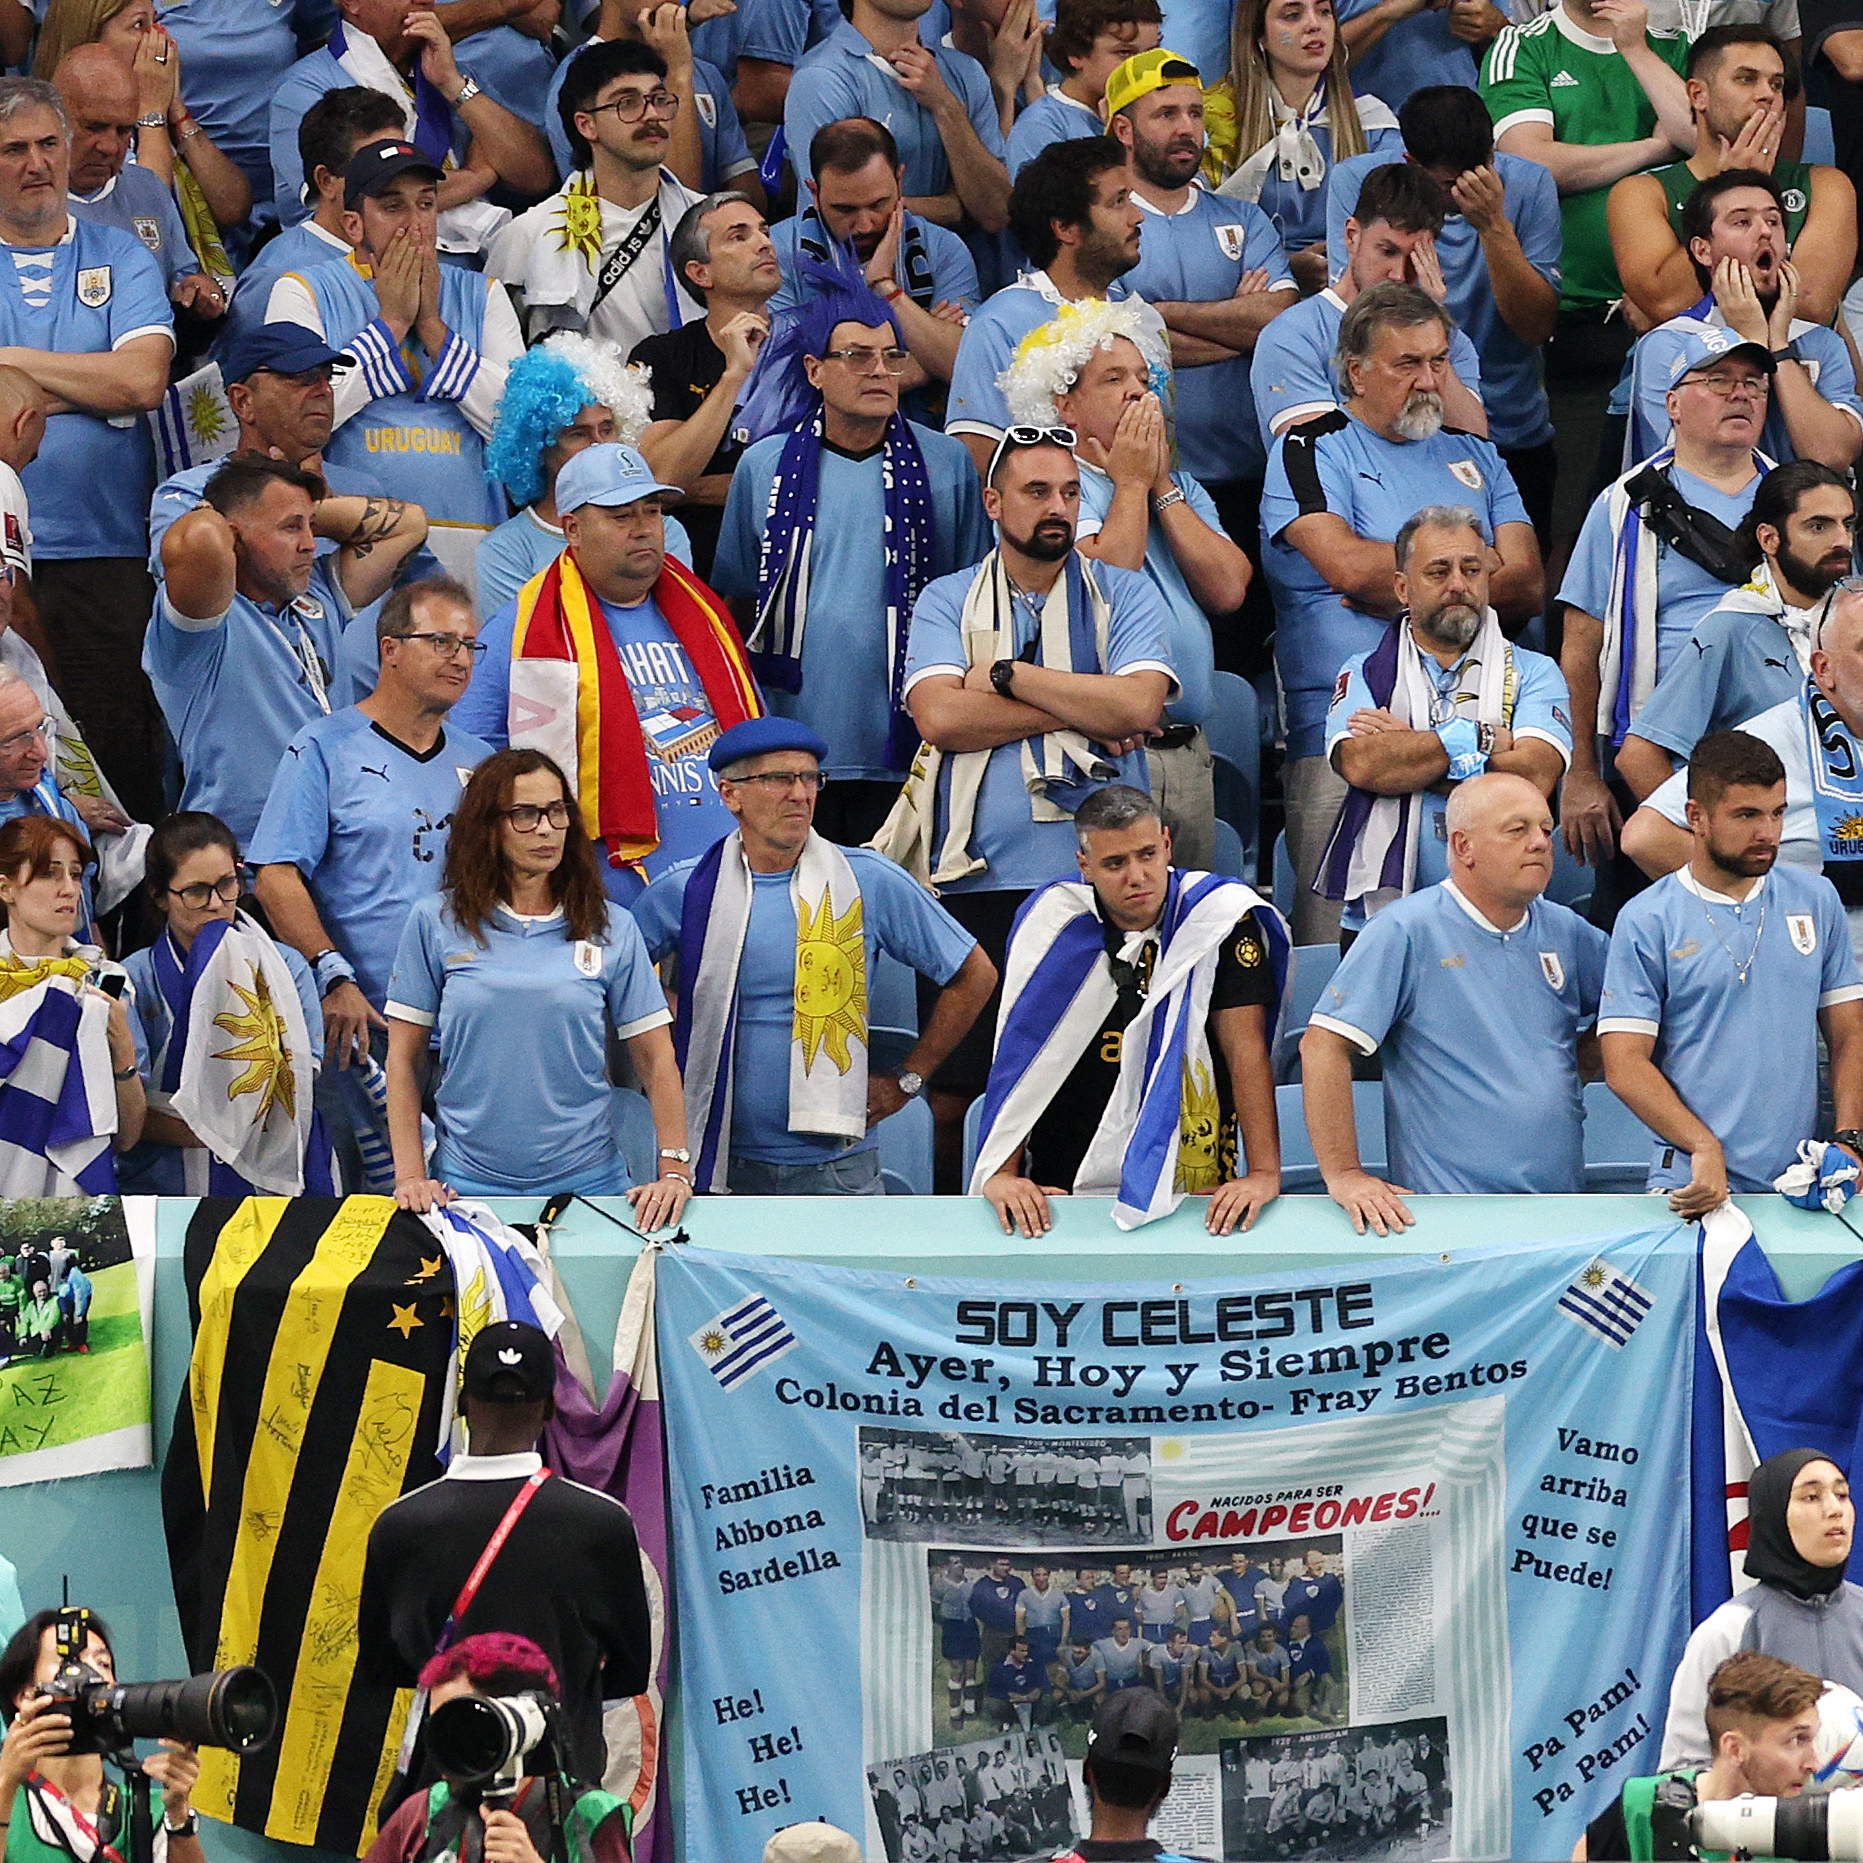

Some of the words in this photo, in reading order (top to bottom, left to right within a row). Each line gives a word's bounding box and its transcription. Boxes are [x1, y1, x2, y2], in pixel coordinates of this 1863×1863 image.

[365, 428, 461, 455] URUGUAY
[955, 1300, 1085, 1348] SOY
[1102, 1282, 1374, 1346] CELESTE
[866, 1341, 1011, 1393] Ayer,
[1034, 1355, 1146, 1398] Hoy
[1165, 1362, 1200, 1397] y
[1218, 1328, 1452, 1384] Siempre
[775, 1377, 924, 1418] Colonia
[939, 1393, 1001, 1424] del
[1289, 1385, 1382, 1416] Fray
[1394, 1358, 1528, 1400] Bentos
[1557, 1427, 1639, 1465] Vamo
[701, 1463, 815, 1509] Familia
[1210, 1492, 1271, 1508] NACIDOS
[1275, 1488, 1313, 1504] PARA
[1316, 1484, 1344, 1498] SER
[1540, 1472, 1629, 1507] arriba
[715, 1508, 826, 1551] Abbona
[1521, 1511, 1578, 1541] que
[1586, 1524, 1617, 1548] se
[718, 1548, 841, 1595] Sardella
[1510, 1549, 1613, 1591] Puede!
[713, 1689, 765, 1725] He!
[1522, 1736, 1566, 1773] Pa
[1563, 1668, 1644, 1738] Pam!
[748, 1726, 803, 1764] He!
[1532, 1782, 1575, 1817] Pa
[1575, 1712, 1653, 1783] Pam!
[735, 1778, 792, 1816] He!
